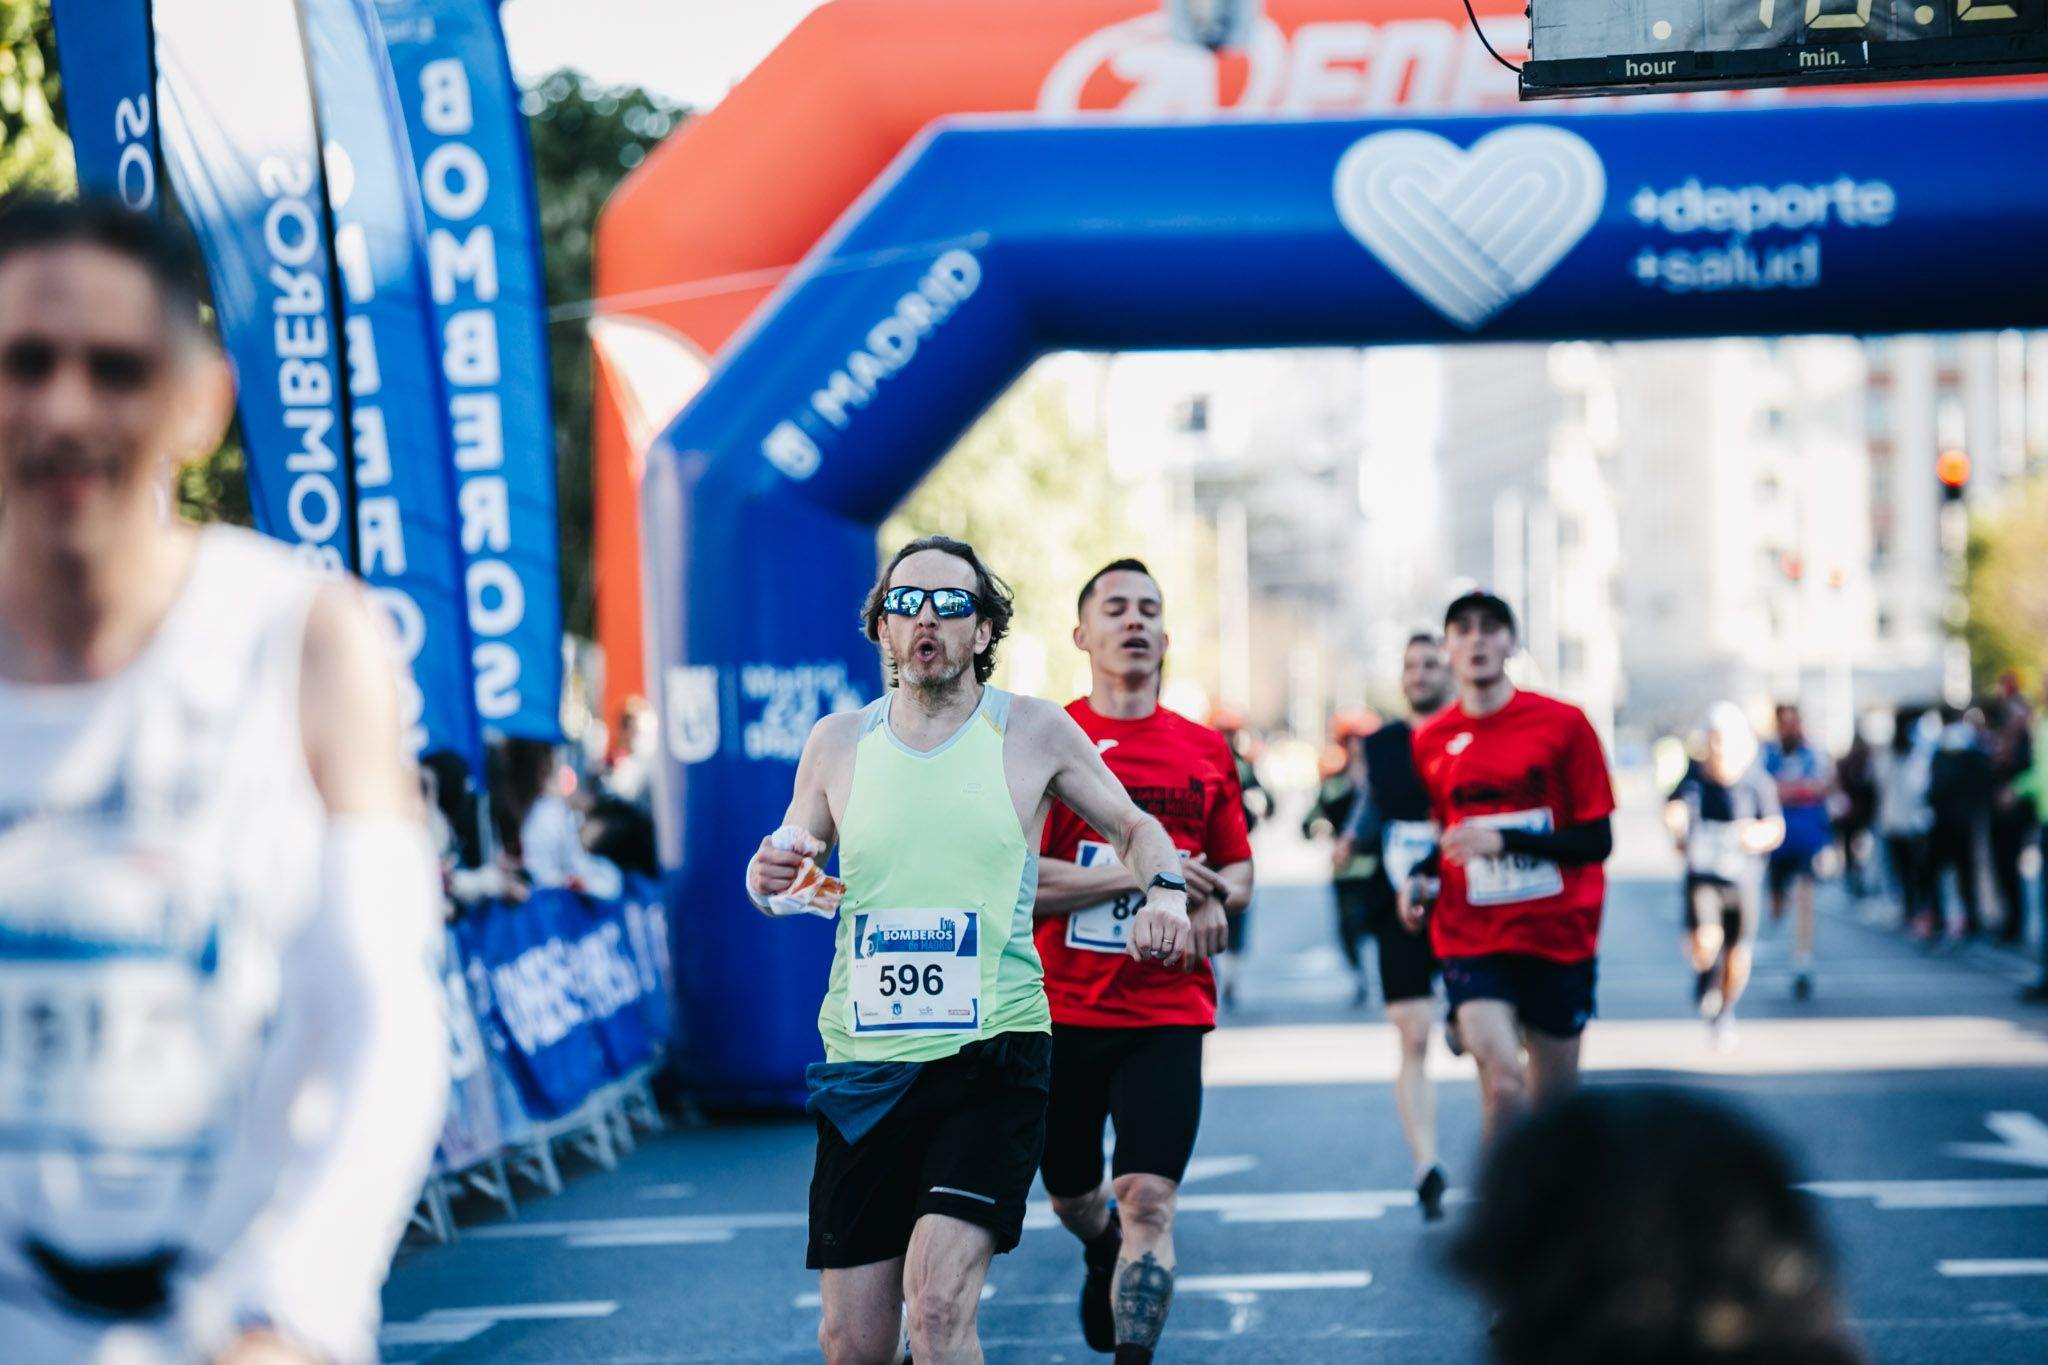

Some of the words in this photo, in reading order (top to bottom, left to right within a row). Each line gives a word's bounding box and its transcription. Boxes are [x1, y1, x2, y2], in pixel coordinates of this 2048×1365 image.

[1625, 57, 1677, 77] hour
[1800, 50, 1846, 67] min.
[811, 248, 981, 429] MADRID
[883, 930, 953, 941] BOMBEROS
[880, 964, 944, 997] 596
